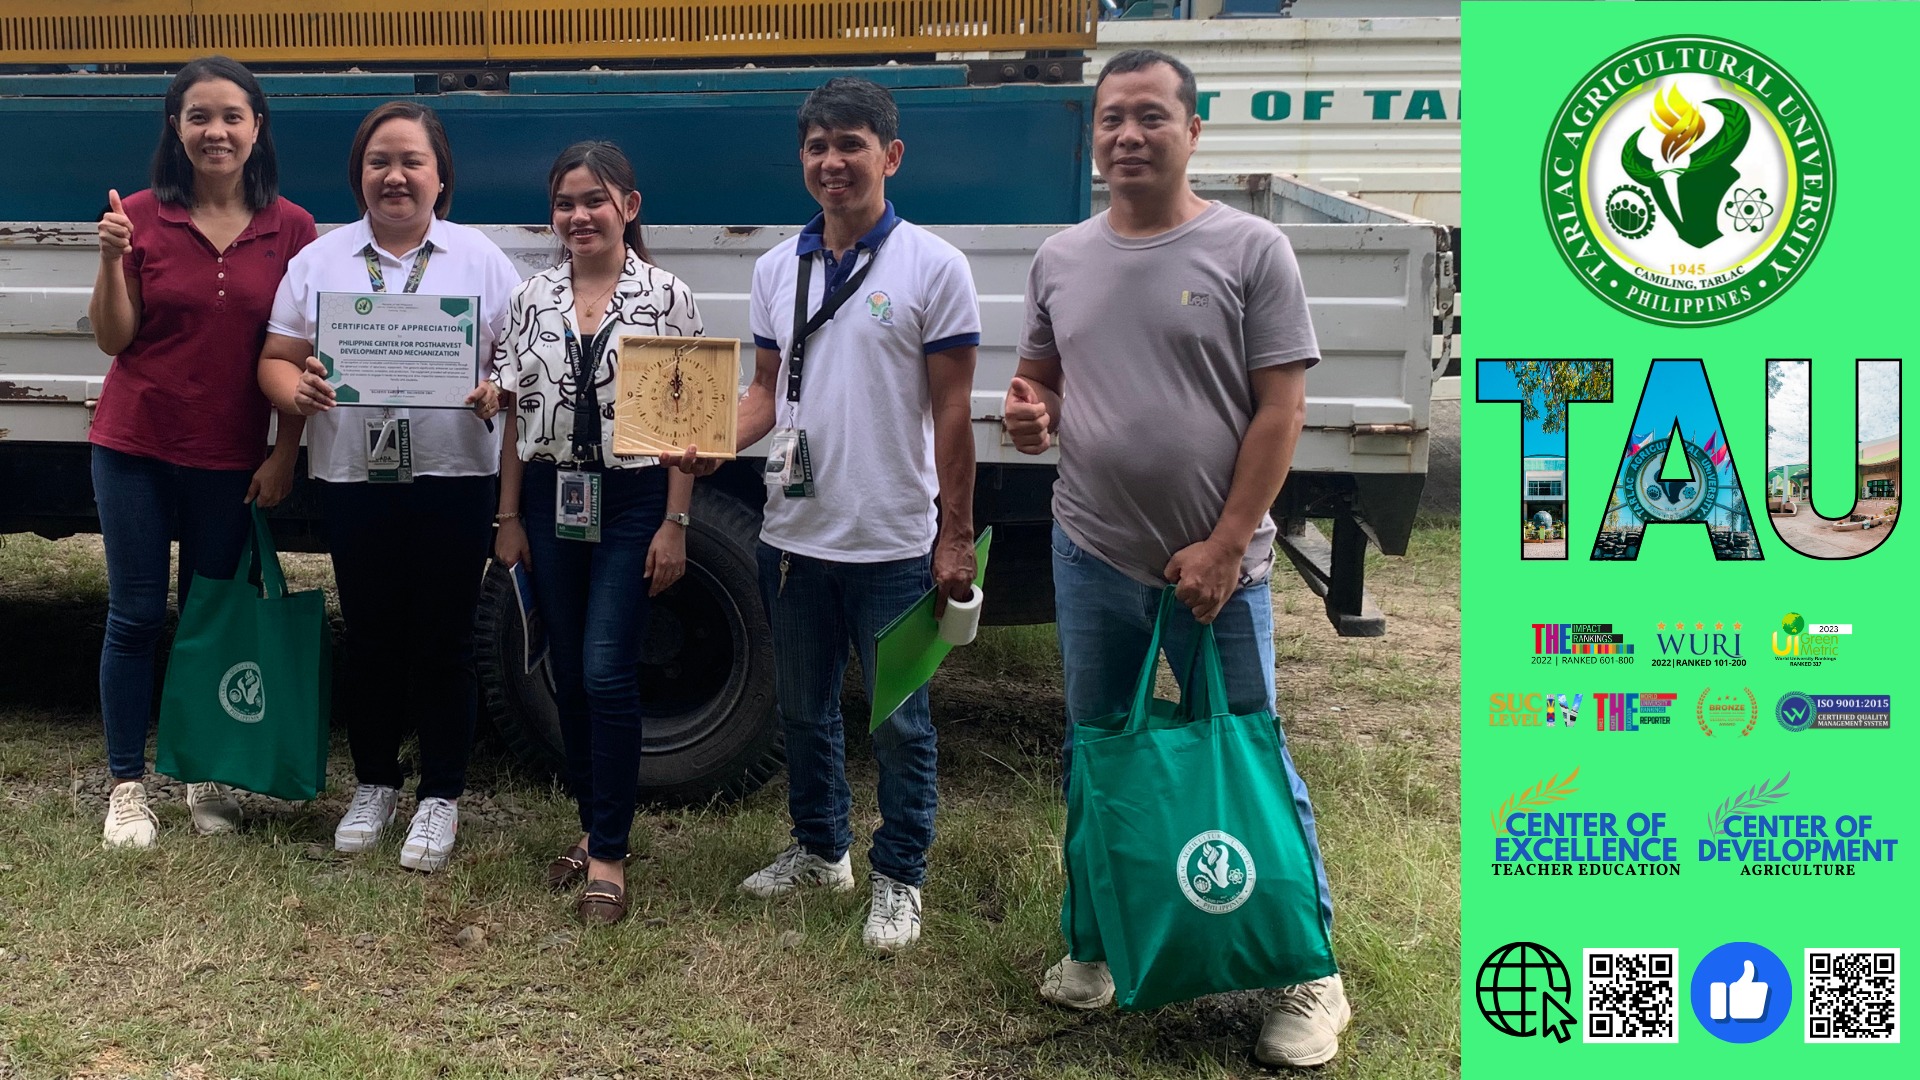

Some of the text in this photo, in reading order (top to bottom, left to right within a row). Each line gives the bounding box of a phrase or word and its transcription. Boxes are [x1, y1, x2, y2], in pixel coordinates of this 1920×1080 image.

[1251, 90, 1334, 121] OF
[1363, 90, 1461, 120] TA
[332, 323, 385, 331] CERTIFICATE
[402, 324, 463, 333] APPRECIATION
[415, 341, 462, 349] POSTHARVEST
[340, 348, 388, 356] DEVELOPMENT
[404, 349, 460, 357] MECHANIZATION
[674, 348, 683, 356] 12
[720, 394, 725, 402] 3
